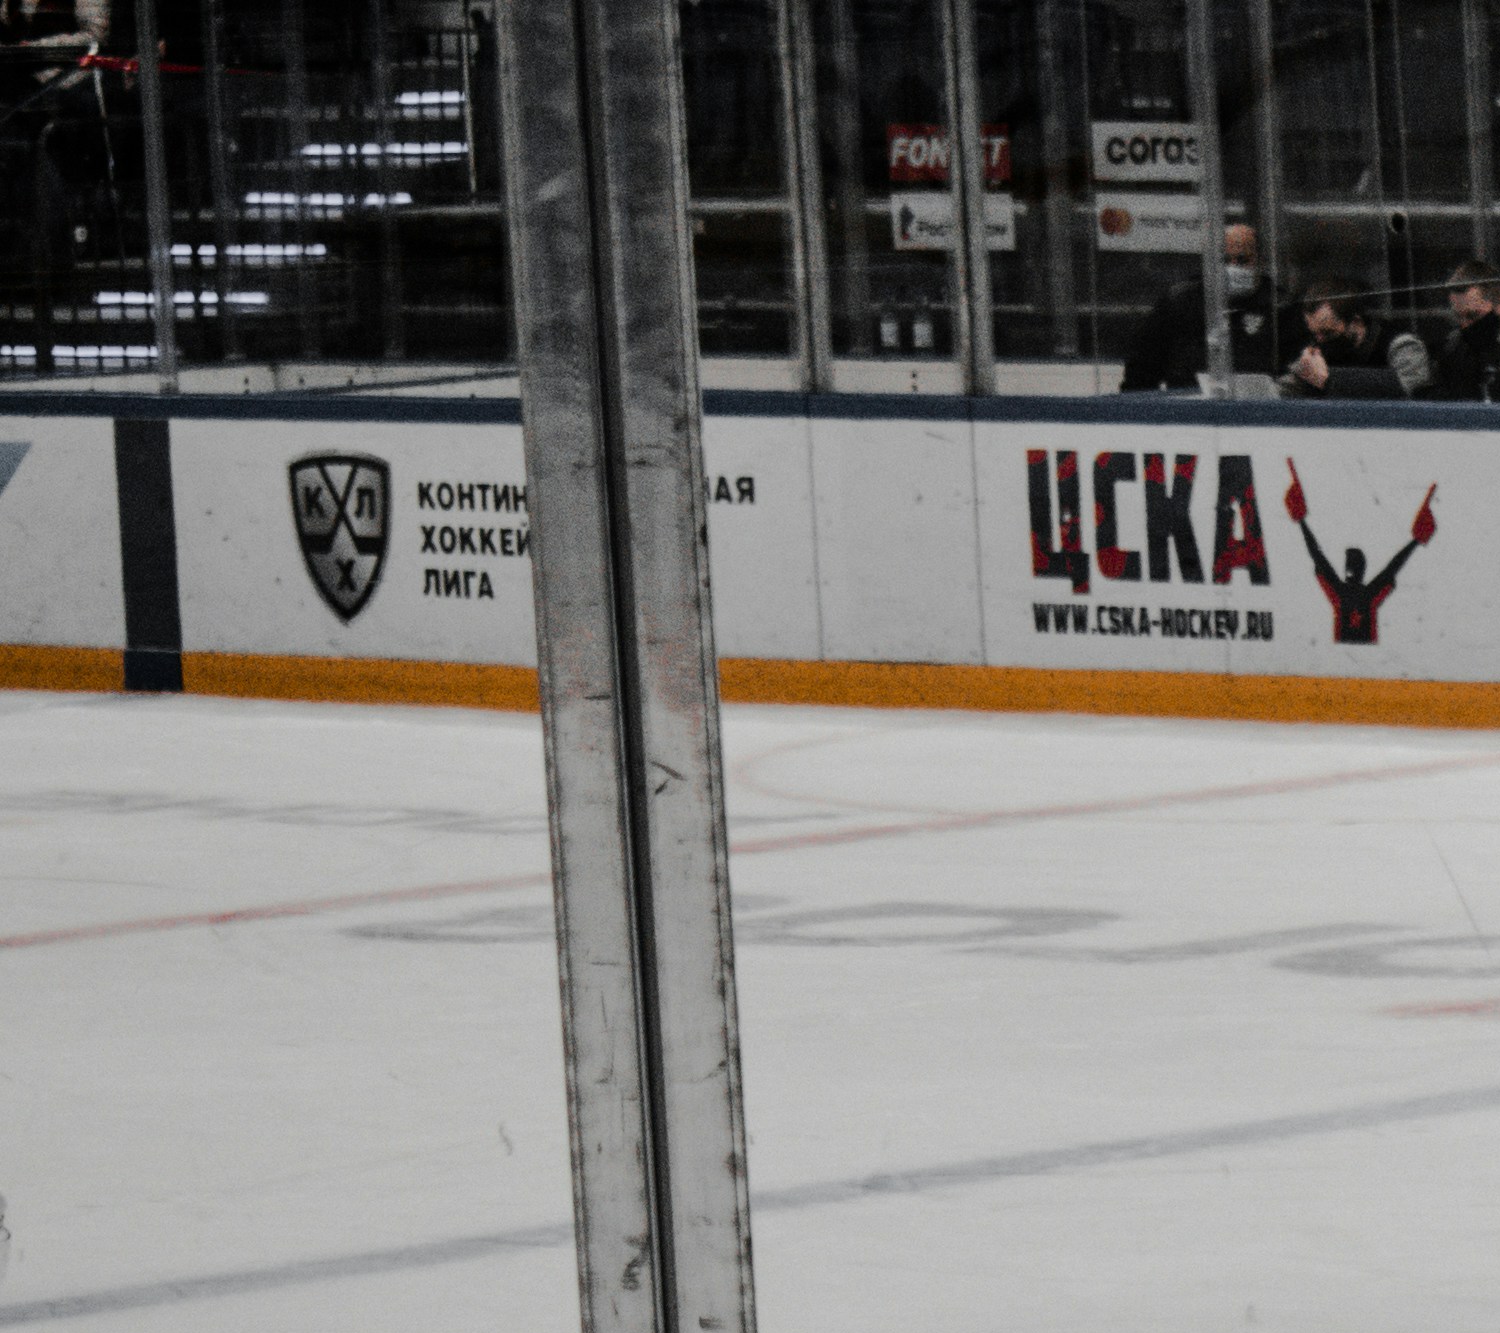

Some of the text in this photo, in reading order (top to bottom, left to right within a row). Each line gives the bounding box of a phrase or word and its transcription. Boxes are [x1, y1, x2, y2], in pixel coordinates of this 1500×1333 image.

[890, 136, 1008, 168] FONT
[421, 522, 531, 556] ХОККЕЙ
[1026, 449, 1270, 595] ЦСКА
[423, 569, 495, 600] ЛИГА
[1033, 603, 1274, 641] WWW.CSKA-HOCKEY.RU
